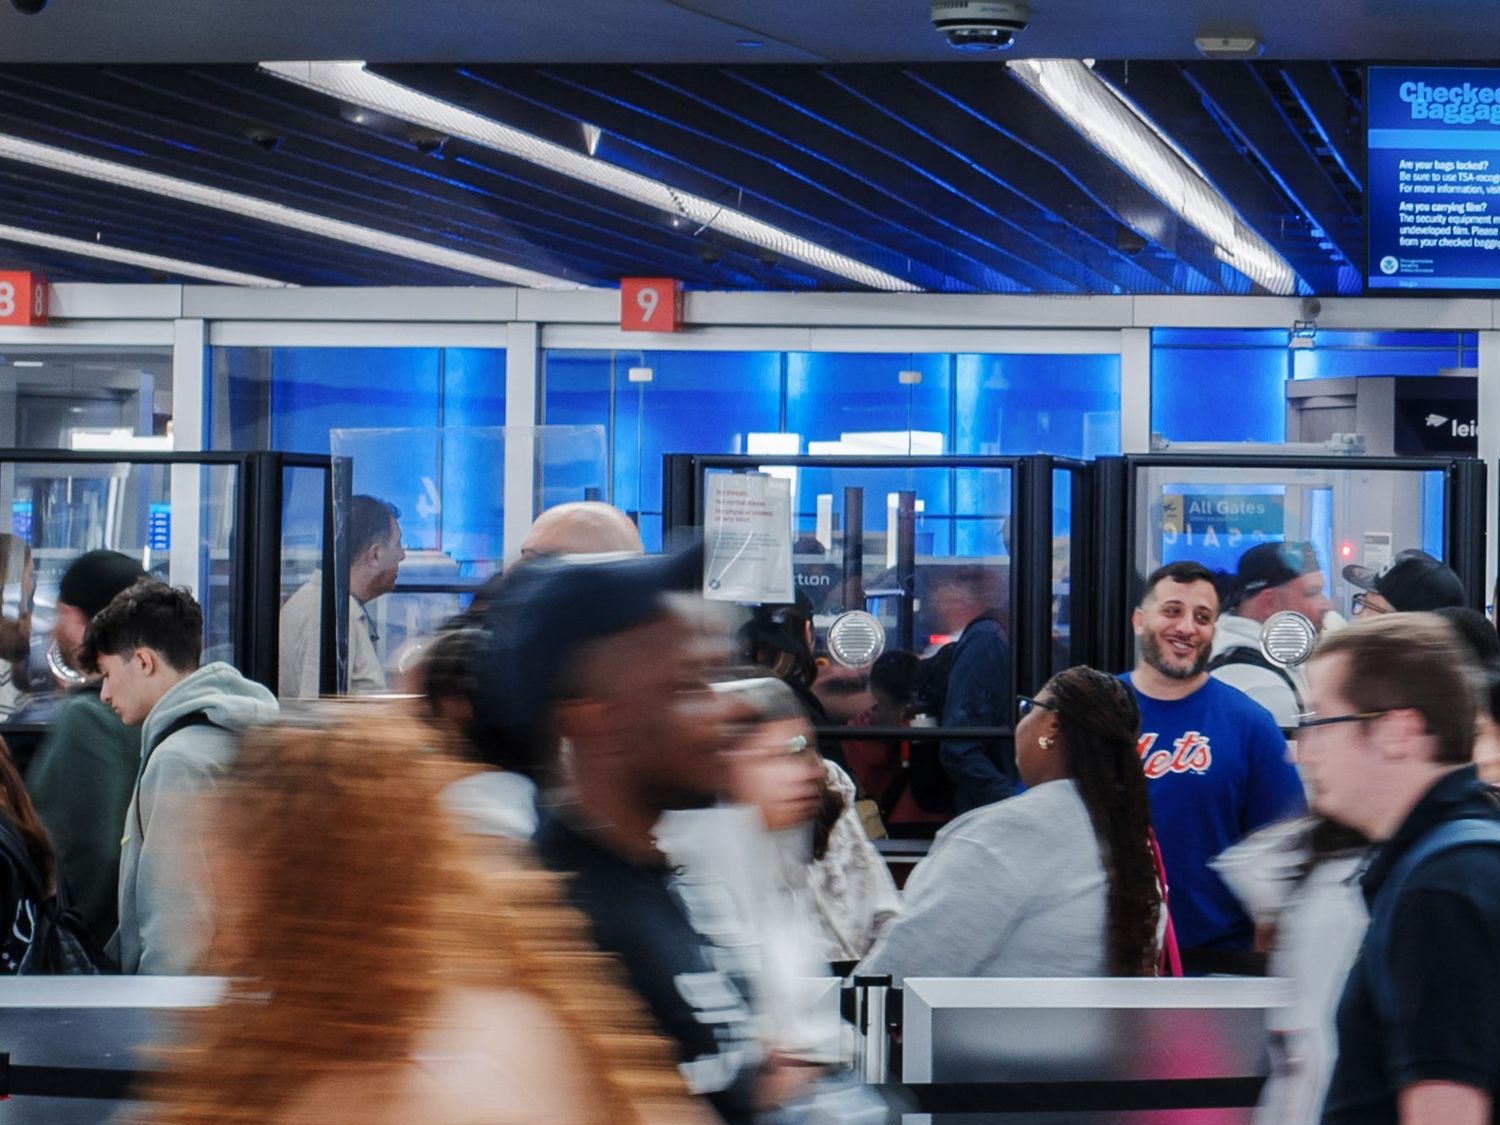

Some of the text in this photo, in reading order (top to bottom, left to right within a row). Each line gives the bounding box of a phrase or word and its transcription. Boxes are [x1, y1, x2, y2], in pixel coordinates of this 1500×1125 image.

[1399, 160, 1489, 172] Are your bags locked?
[1399, 171, 1411, 181] Be
[1413, 173, 1430, 181] sure
[1432, 172, 1440, 181] to
[1442, 173, 1456, 181] use
[1399, 183, 1413, 193] For
[1414, 185, 1435, 193] more
[1437, 184, 1485, 195] information,
[1399, 201, 1414, 211] Are
[1415, 203, 1430, 213] you
[1431, 202, 1465, 214] carrying
[1399, 213, 1414, 223] The
[1415, 214, 1446, 225] security
[1448, 215, 1491, 225] equipment
[1400, 225, 1451, 236] undeveloped
[1471, 226, 1498, 236] Please
[1399, 237, 1419, 246] from
[1420, 238, 1438, 248] your
[1438, 237, 1473, 247] checked
[0, 281, 16, 317] 8
[637, 287, 658, 322] 9
[1452, 419, 1478, 437] lei
[1189, 500, 1266, 515] All Gates
[797, 574, 830, 586] tion
